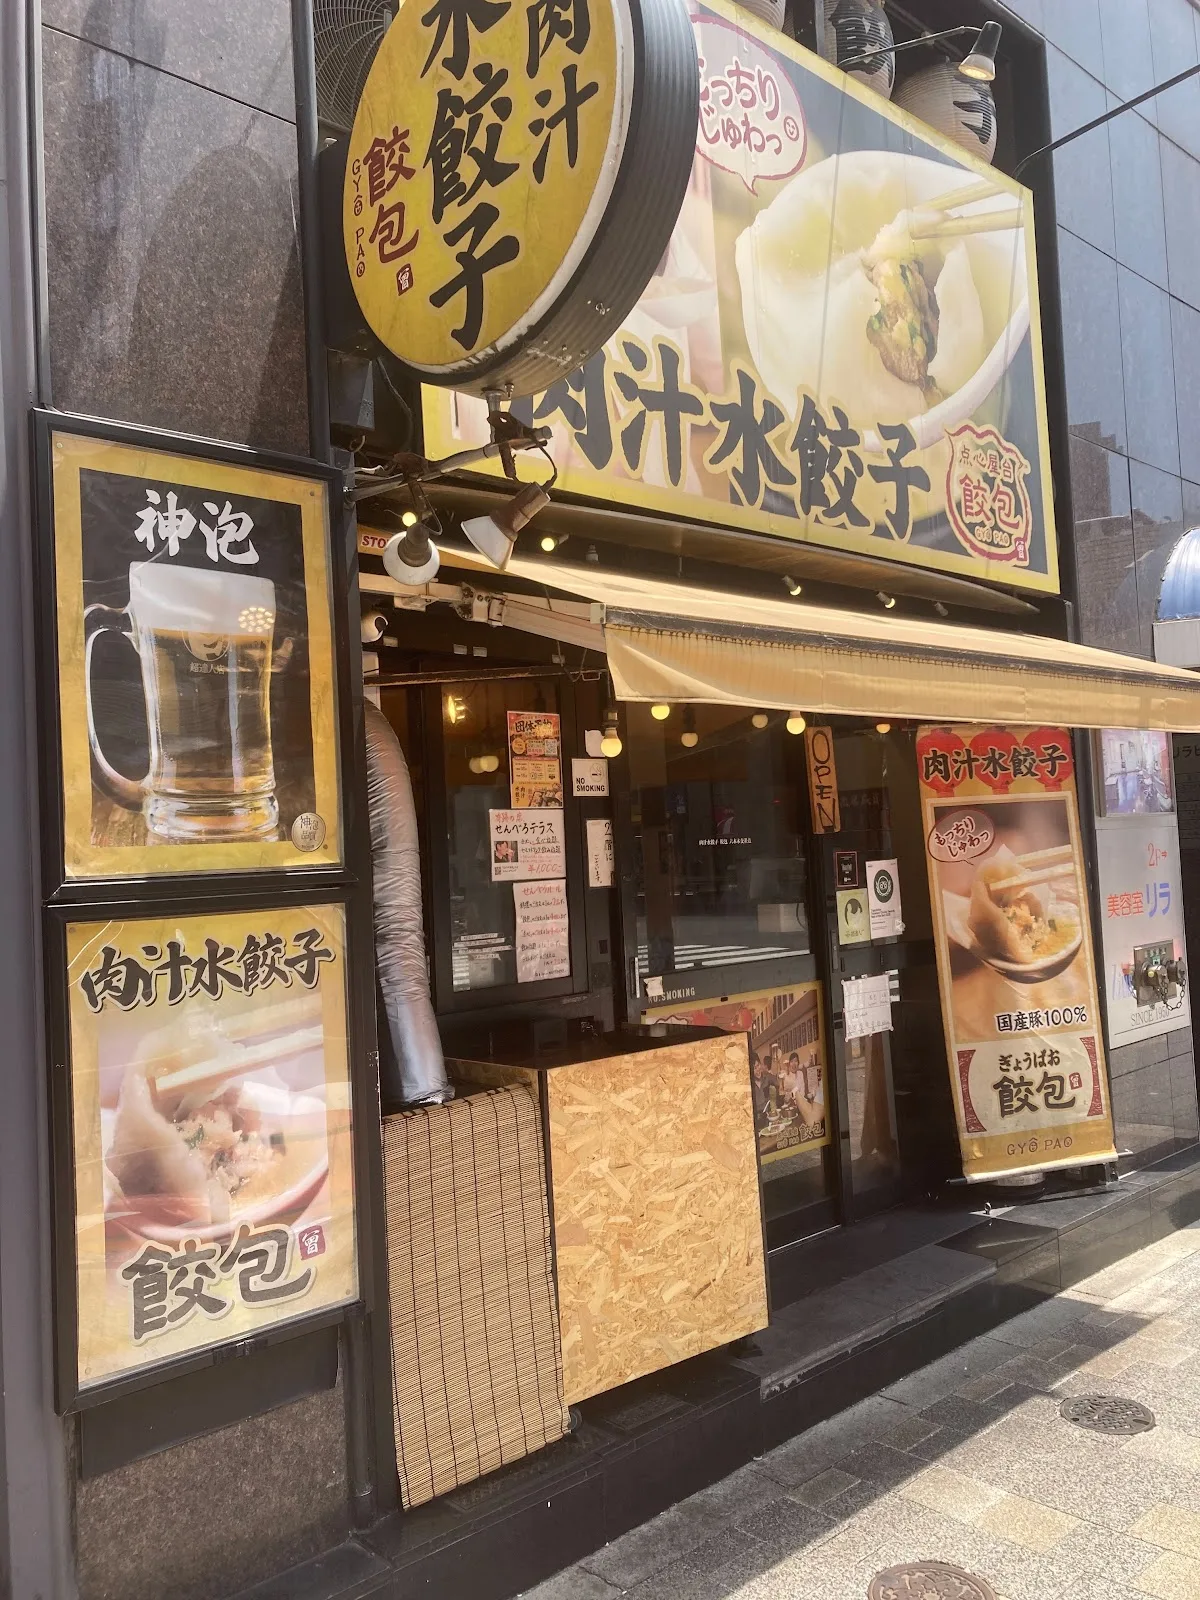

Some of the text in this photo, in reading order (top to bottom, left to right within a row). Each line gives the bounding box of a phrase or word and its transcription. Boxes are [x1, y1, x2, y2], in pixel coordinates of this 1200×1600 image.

[697, 57, 780, 121] っちり
[700, 104, 783, 156] じゅわっ
[362, 126, 419, 263] 餃包
[420, 0, 520, 351] 水餃子
[510, 340, 931, 540] 肉汁水餃子
[959, 444, 1012, 480] 点心屋台
[959, 473, 1020, 530] 餃包
[134, 489, 259, 565] 神泡
[362, 535, 388, 549] STO
[811, 729, 837, 832] OPEN
[923, 744, 1068, 782] 肉汁水餃子
[495, 821, 555, 835] せんべろテラス
[934, 817, 976, 846] もっちり
[948, 831, 990, 858] じゅわっ
[1148, 842, 1160, 867] 2F
[1107, 882, 1171, 918] 美容室 リラ
[81, 928, 333, 1008] 肉汁水餃子
[996, 1006, 1088, 1032] 国産豚100%
[1131, 1009, 1153, 1027] SINCE
[998, 1049, 1061, 1072] ぎょうぱお
[993, 1071, 1076, 1119] 餃包
[121, 1225, 313, 1340] 餃包
